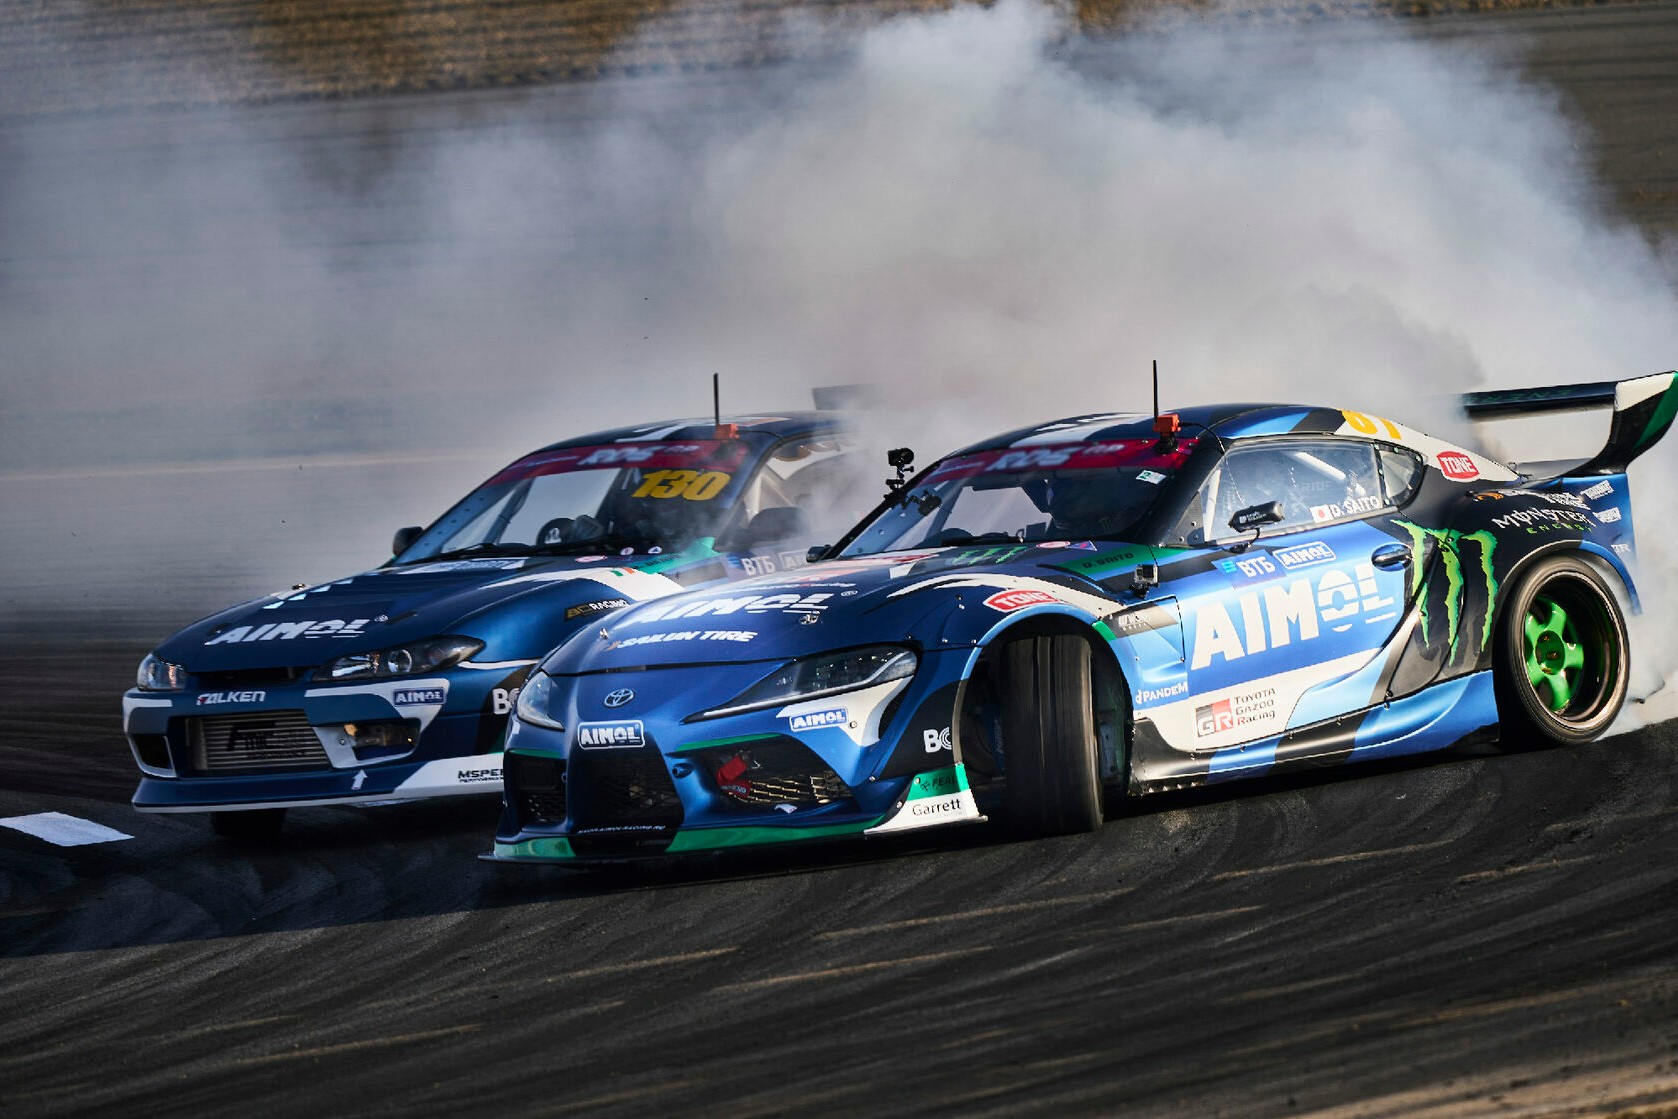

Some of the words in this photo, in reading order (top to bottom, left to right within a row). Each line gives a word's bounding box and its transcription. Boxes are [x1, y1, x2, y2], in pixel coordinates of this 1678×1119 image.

[1440, 456, 1477, 474] TONE
[631, 470, 731, 501] 130
[1344, 496, 1379, 513] SAITO
[1280, 545, 1333, 566] AIMOL
[1236, 556, 1276, 578] ВТБ
[1191, 564, 1396, 670] AIMOL
[205, 619, 369, 645] AIMOL
[196, 691, 266, 706] FALKEN
[396, 691, 443, 703] AIMOL
[1144, 682, 1188, 702] PANDEM
[1234, 688, 1276, 705] TOYOTA
[1235, 699, 1274, 716] GAZOO
[793, 711, 846, 729] AIMOL
[1198, 711, 1233, 735] GR
[1237, 709, 1276, 728] Racing
[581, 727, 640, 745] AIMOL
[912, 798, 961, 816] Garrett
